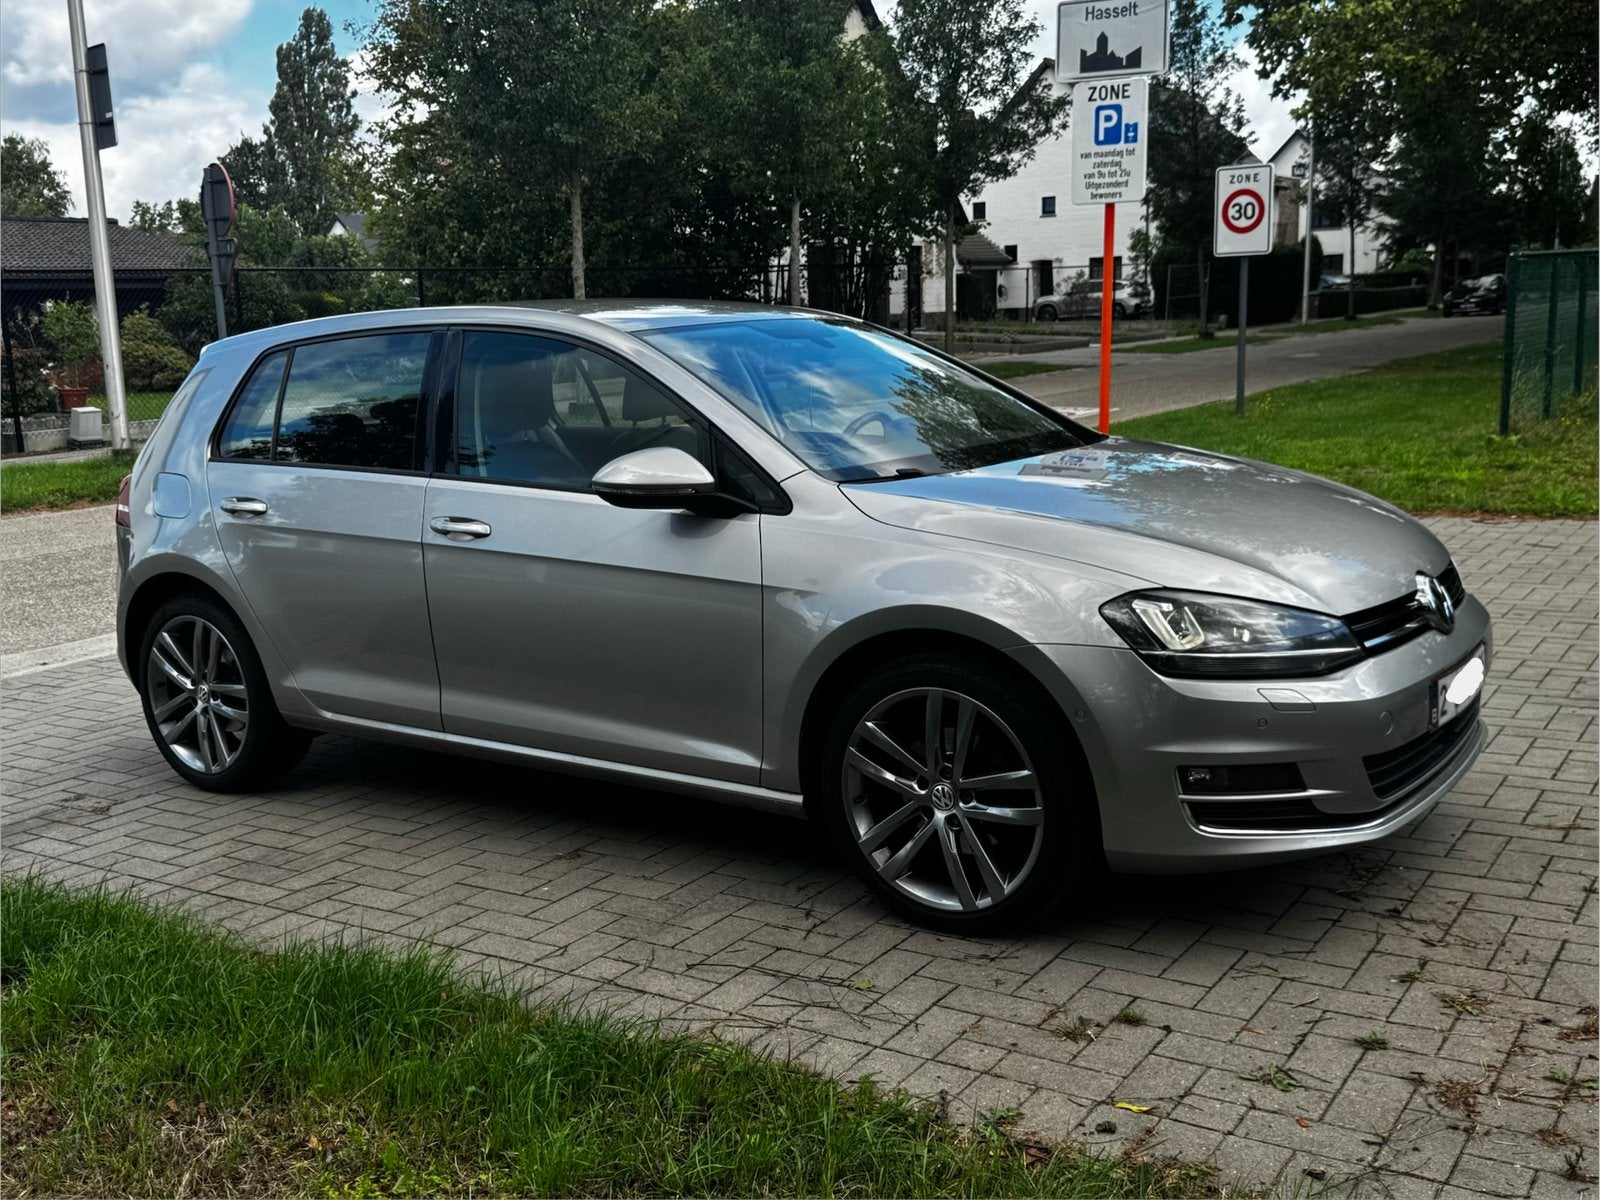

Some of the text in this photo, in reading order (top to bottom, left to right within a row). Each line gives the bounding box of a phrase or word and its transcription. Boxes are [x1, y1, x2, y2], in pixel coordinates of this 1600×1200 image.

[1085, 1, 1138, 21] Hasselt
[1088, 83, 1131, 102] ZONE
[1098, 109, 1118, 141] P
[1093, 149, 1124, 159] maandag
[1126, 148, 1136, 156] tot
[1092, 159, 1122, 169] zaterdag
[1084, 169, 1131, 180] van 9u tot 21u
[1230, 173, 1260, 184] ZONE
[1085, 180, 1129, 190] Uitgezonderd
[1090, 191, 1122, 200] bewoners
[1231, 202, 1256, 221] 30
